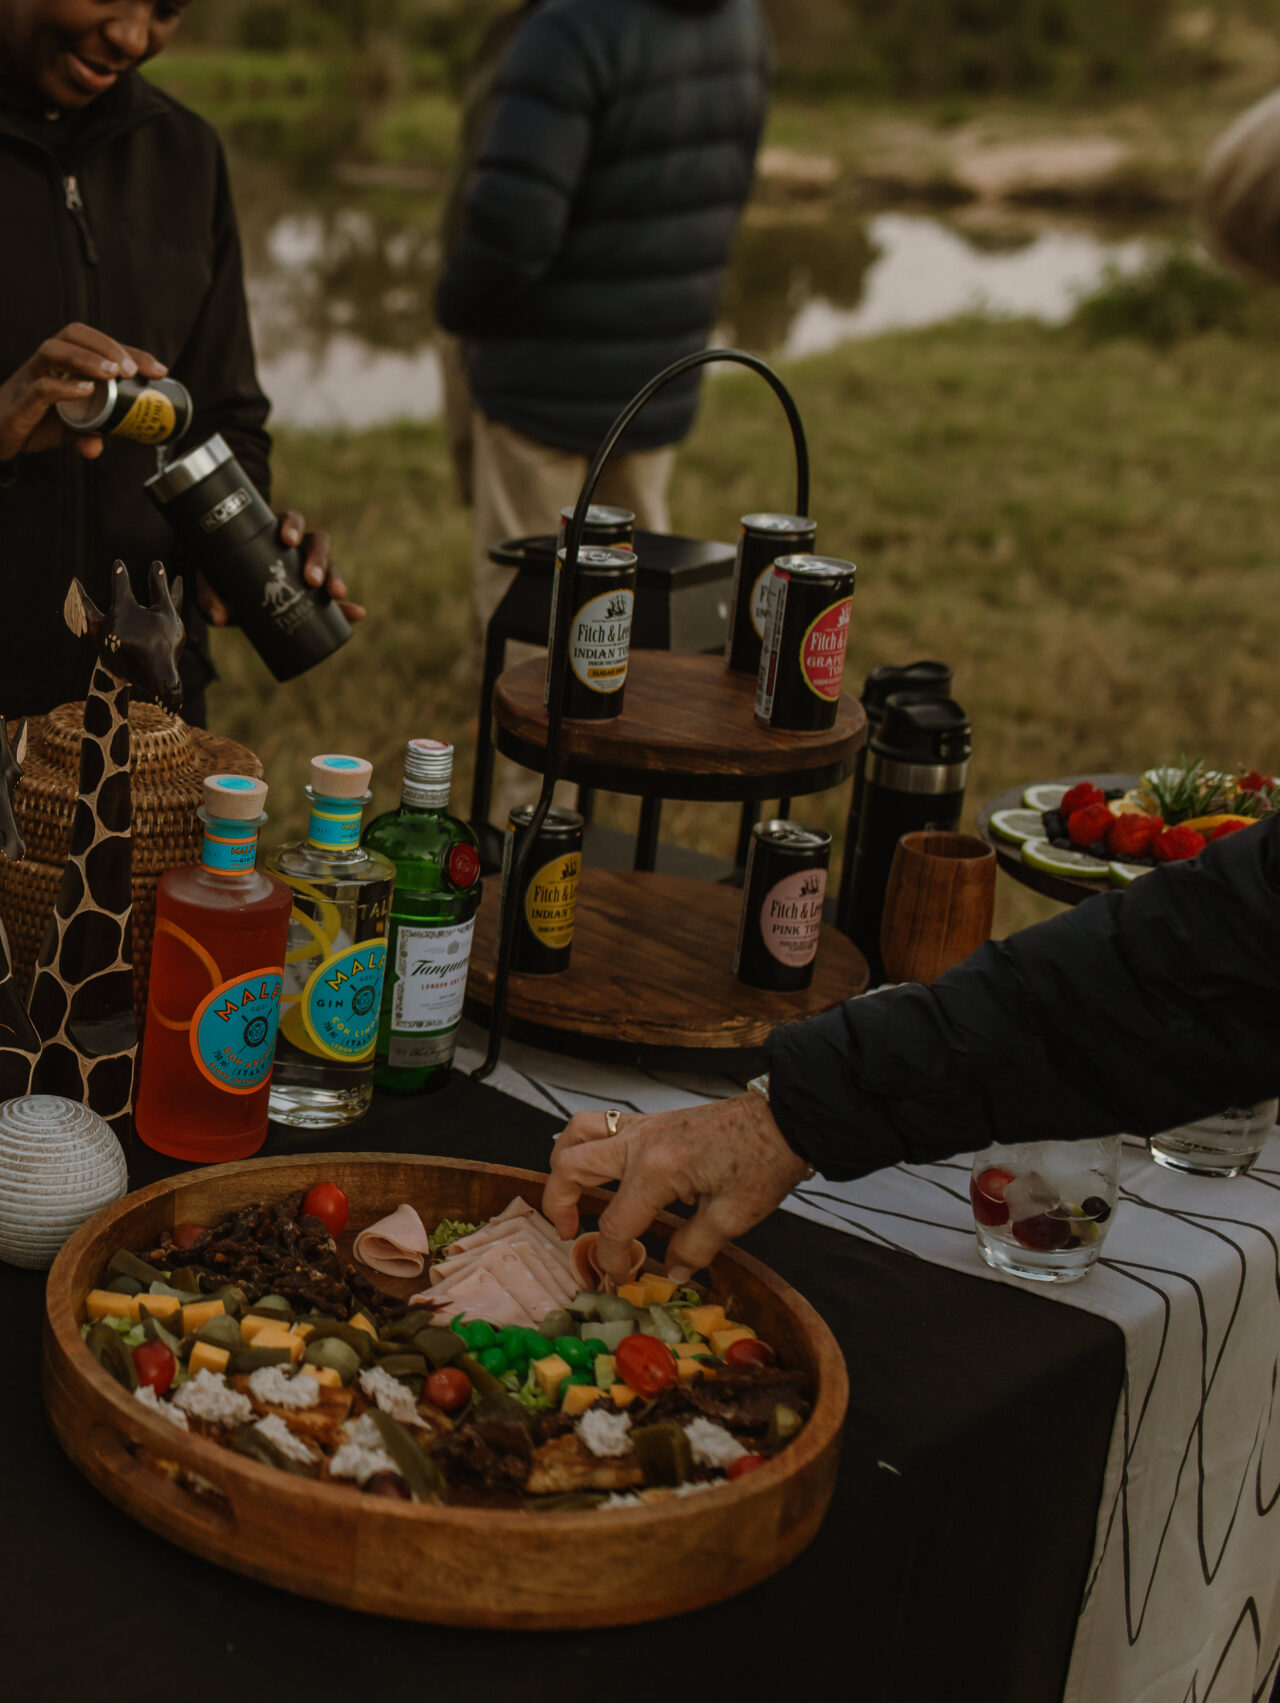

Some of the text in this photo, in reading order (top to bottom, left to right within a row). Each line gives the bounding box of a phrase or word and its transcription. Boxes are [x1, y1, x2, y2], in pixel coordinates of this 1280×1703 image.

[577, 624, 605, 642] Fitch
[608, 624, 616, 642] &
[810, 631, 836, 651] Fitch
[573, 647, 616, 659] INDIAN
[534, 885, 559, 903] Fitch
[531, 908, 567, 919] INDIAN
[770, 899, 798, 920] Fitch
[800, 902, 808, 918] &
[772, 924, 800, 935] PINK
[325, 952, 386, 992] MALF
[214, 982, 281, 1022] MALF
[316, 999, 344, 1008] GIN
